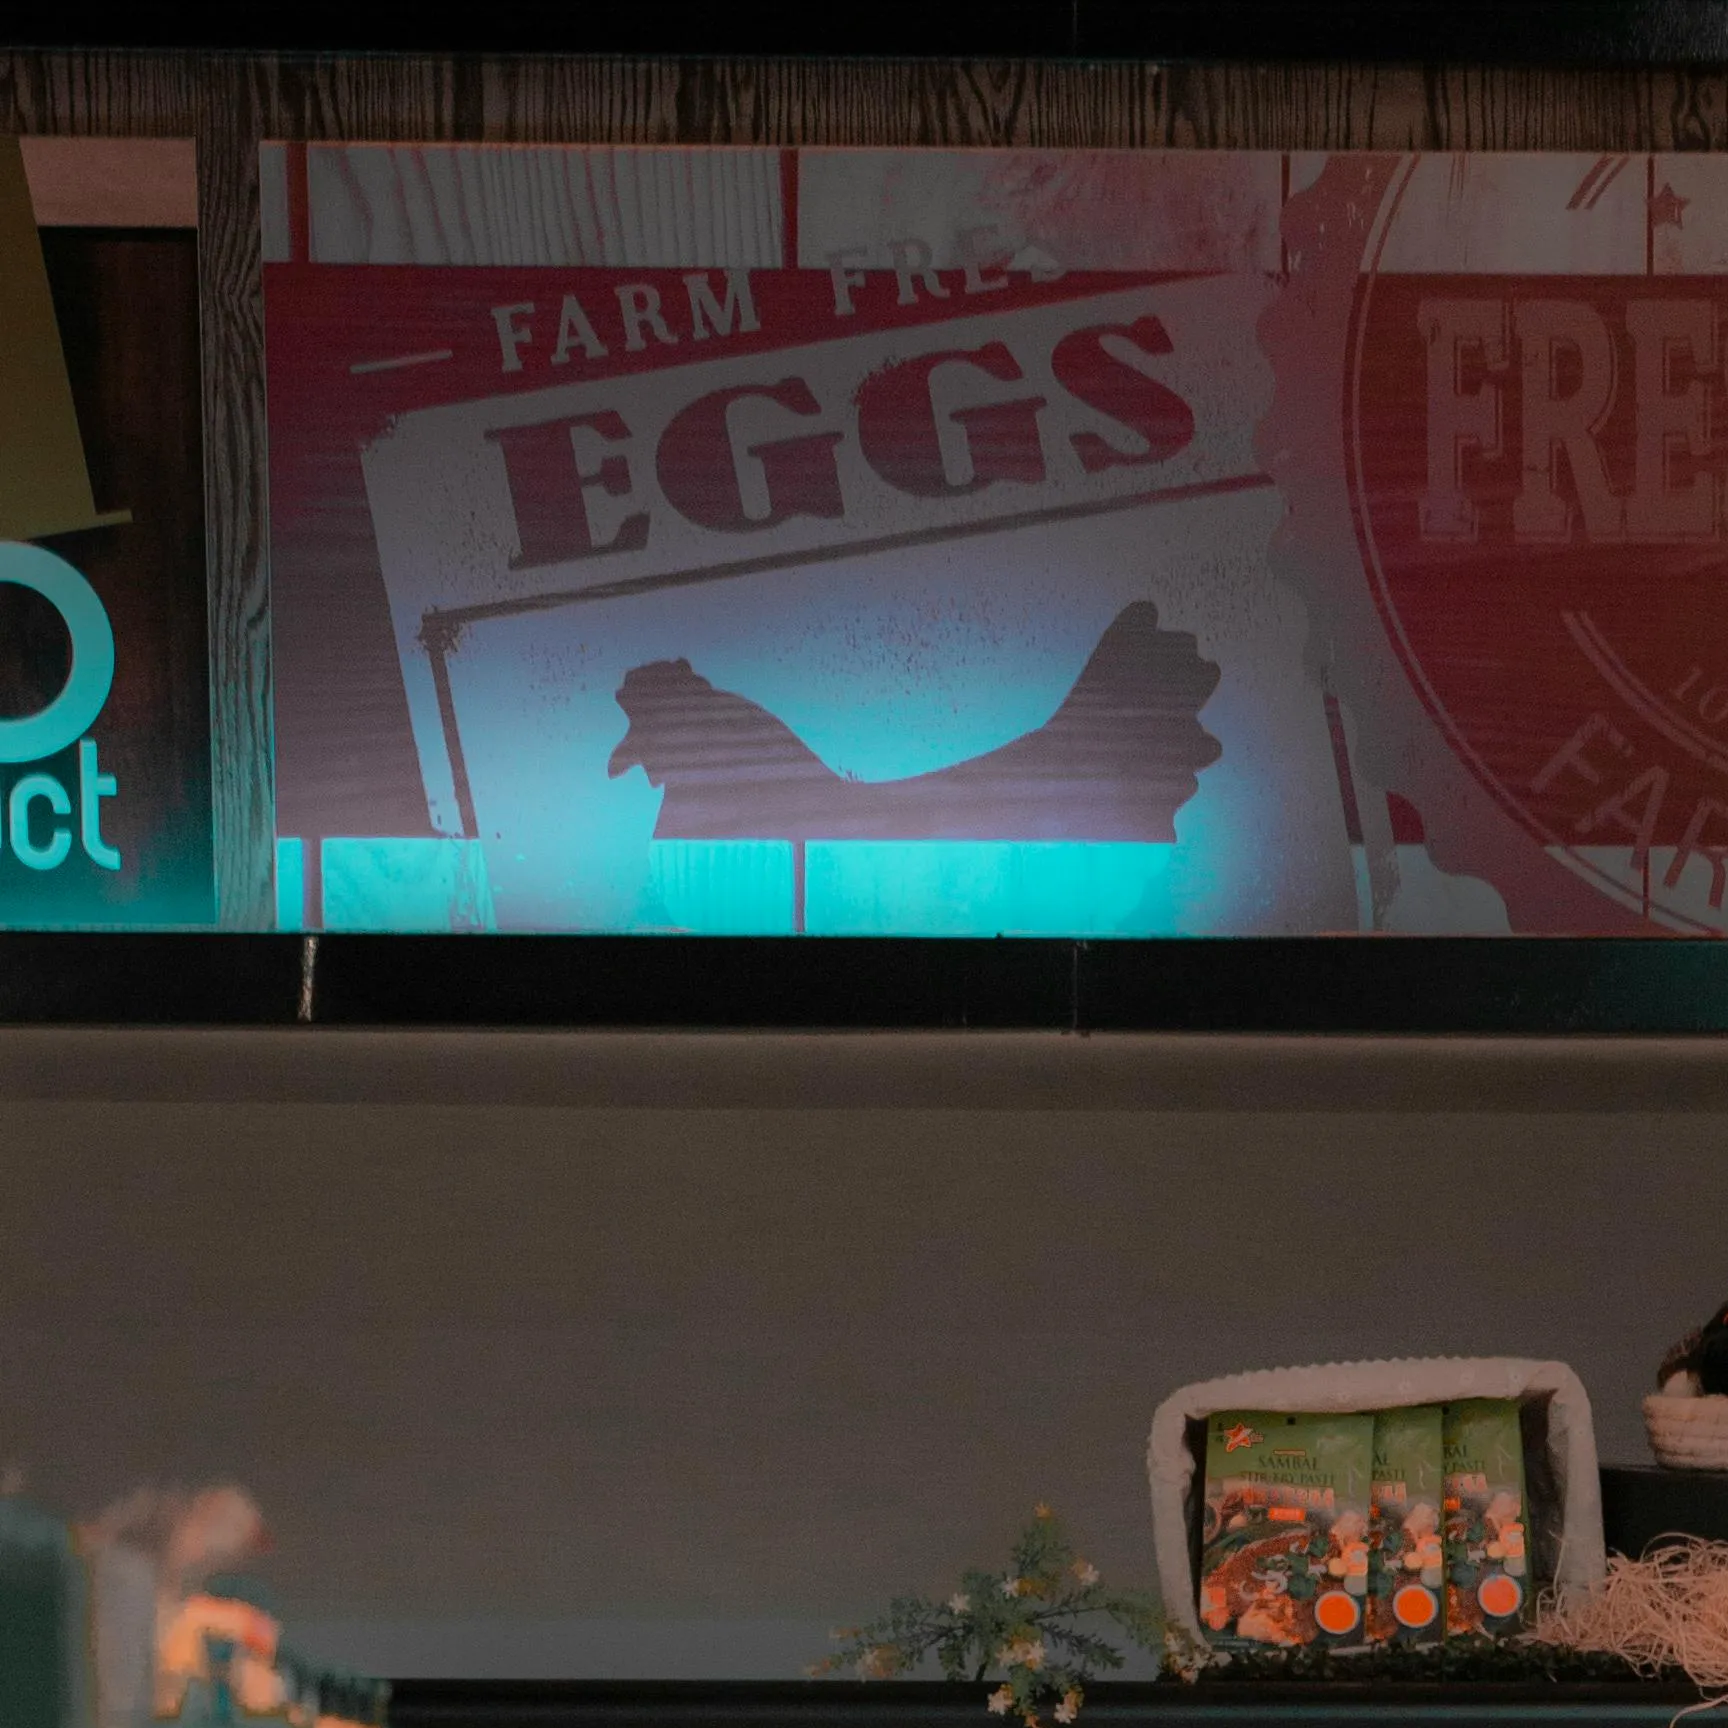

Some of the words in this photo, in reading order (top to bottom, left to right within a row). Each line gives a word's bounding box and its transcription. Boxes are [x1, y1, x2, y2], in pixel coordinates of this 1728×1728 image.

[490, 266, 762, 374] FARM
[828, 226, 1067, 316] FRE
[483, 314, 1196, 570] EGGS
[0, 737, 121, 871] ct
